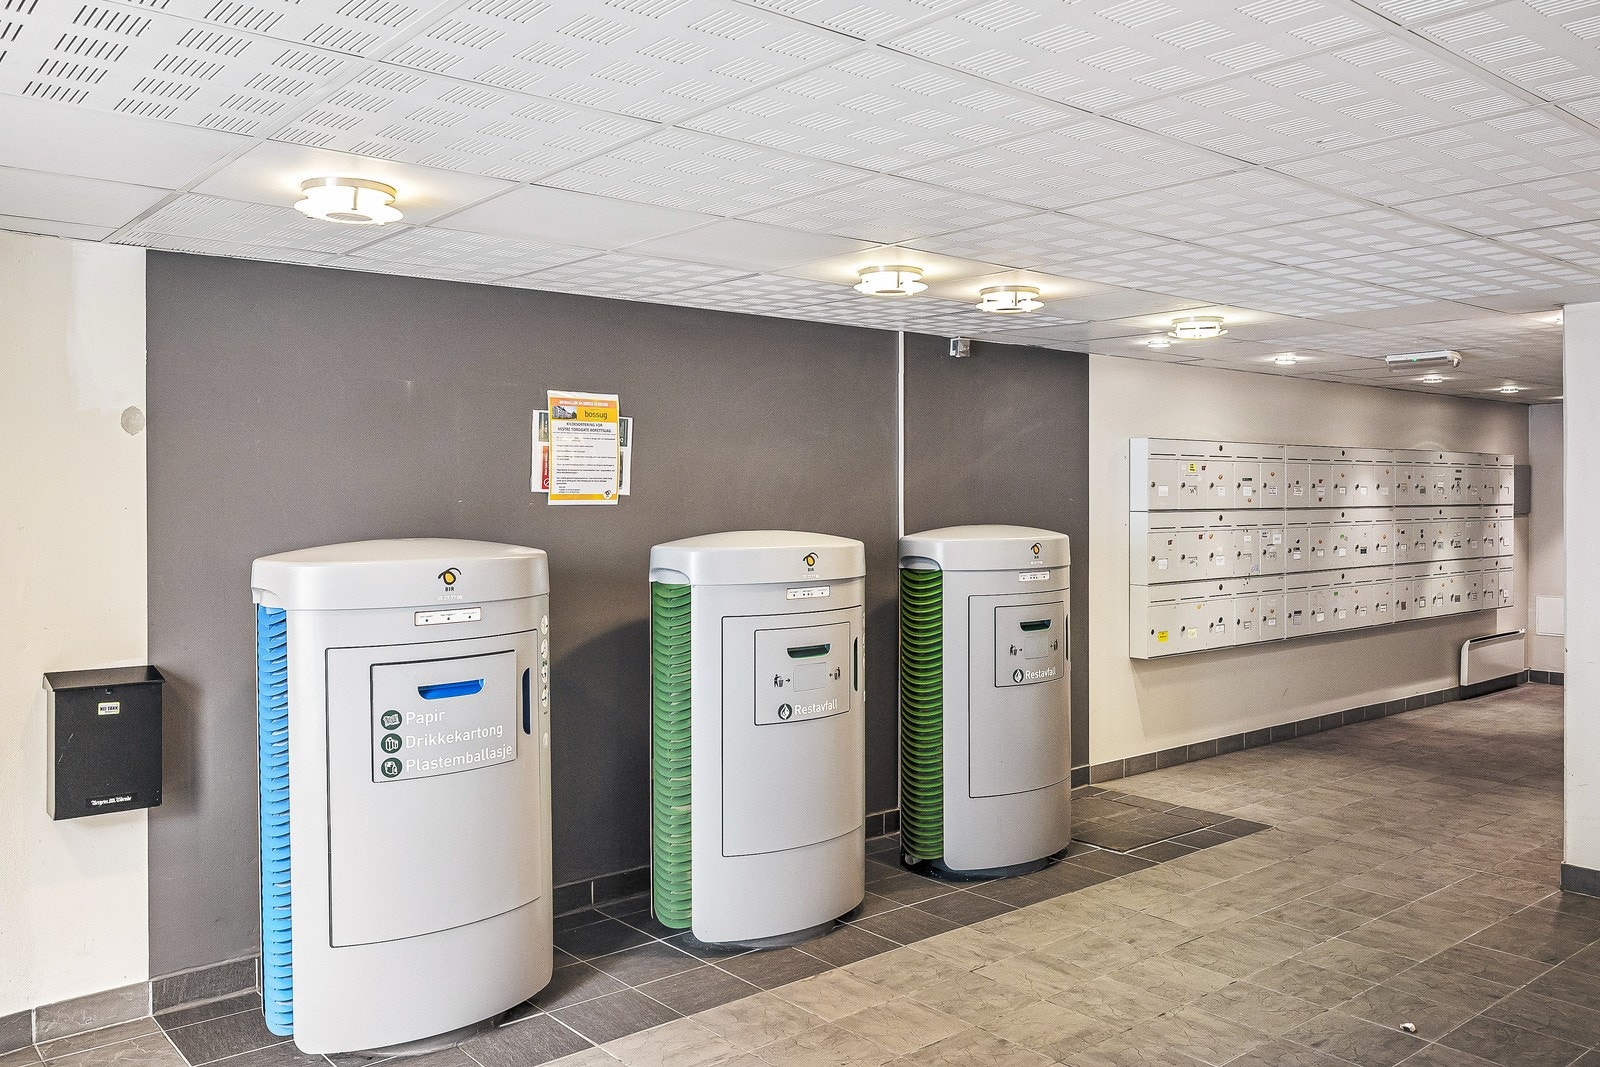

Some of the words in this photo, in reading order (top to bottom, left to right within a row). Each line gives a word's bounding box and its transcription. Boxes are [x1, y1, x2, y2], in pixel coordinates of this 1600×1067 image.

[584, 410, 608, 420] bossug
[1026, 666, 1056, 680] Restavfall
[794, 698, 838, 716] Restavfall
[406, 709, 446, 726] Papir
[405, 724, 503, 750] Drikkekartong
[406, 744, 512, 773] Plastemballasje
